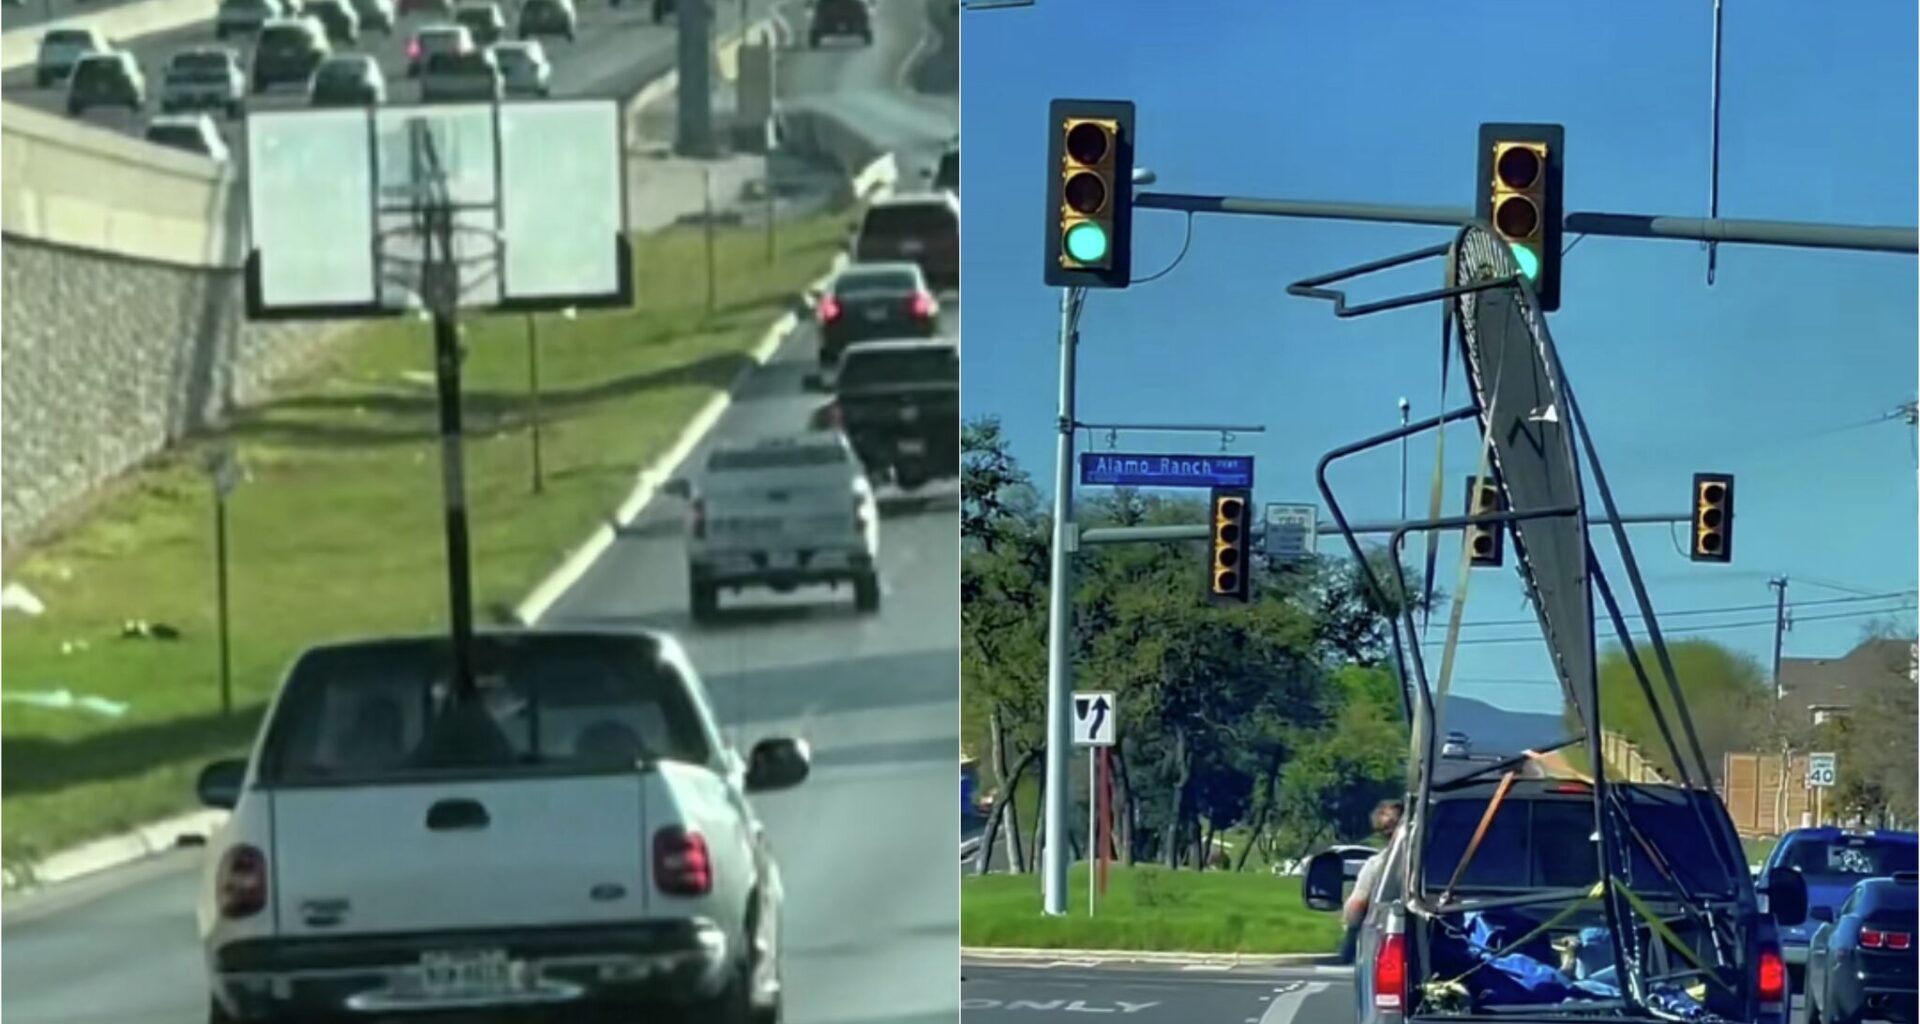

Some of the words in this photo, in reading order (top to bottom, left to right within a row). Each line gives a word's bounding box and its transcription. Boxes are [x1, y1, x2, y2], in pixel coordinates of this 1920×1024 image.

[1097, 456, 1149, 473] Alamo
[1160, 457, 1212, 475] Ranch
[1810, 769, 1834, 783] 40
[961, 998, 1163, 1013] ONLY
